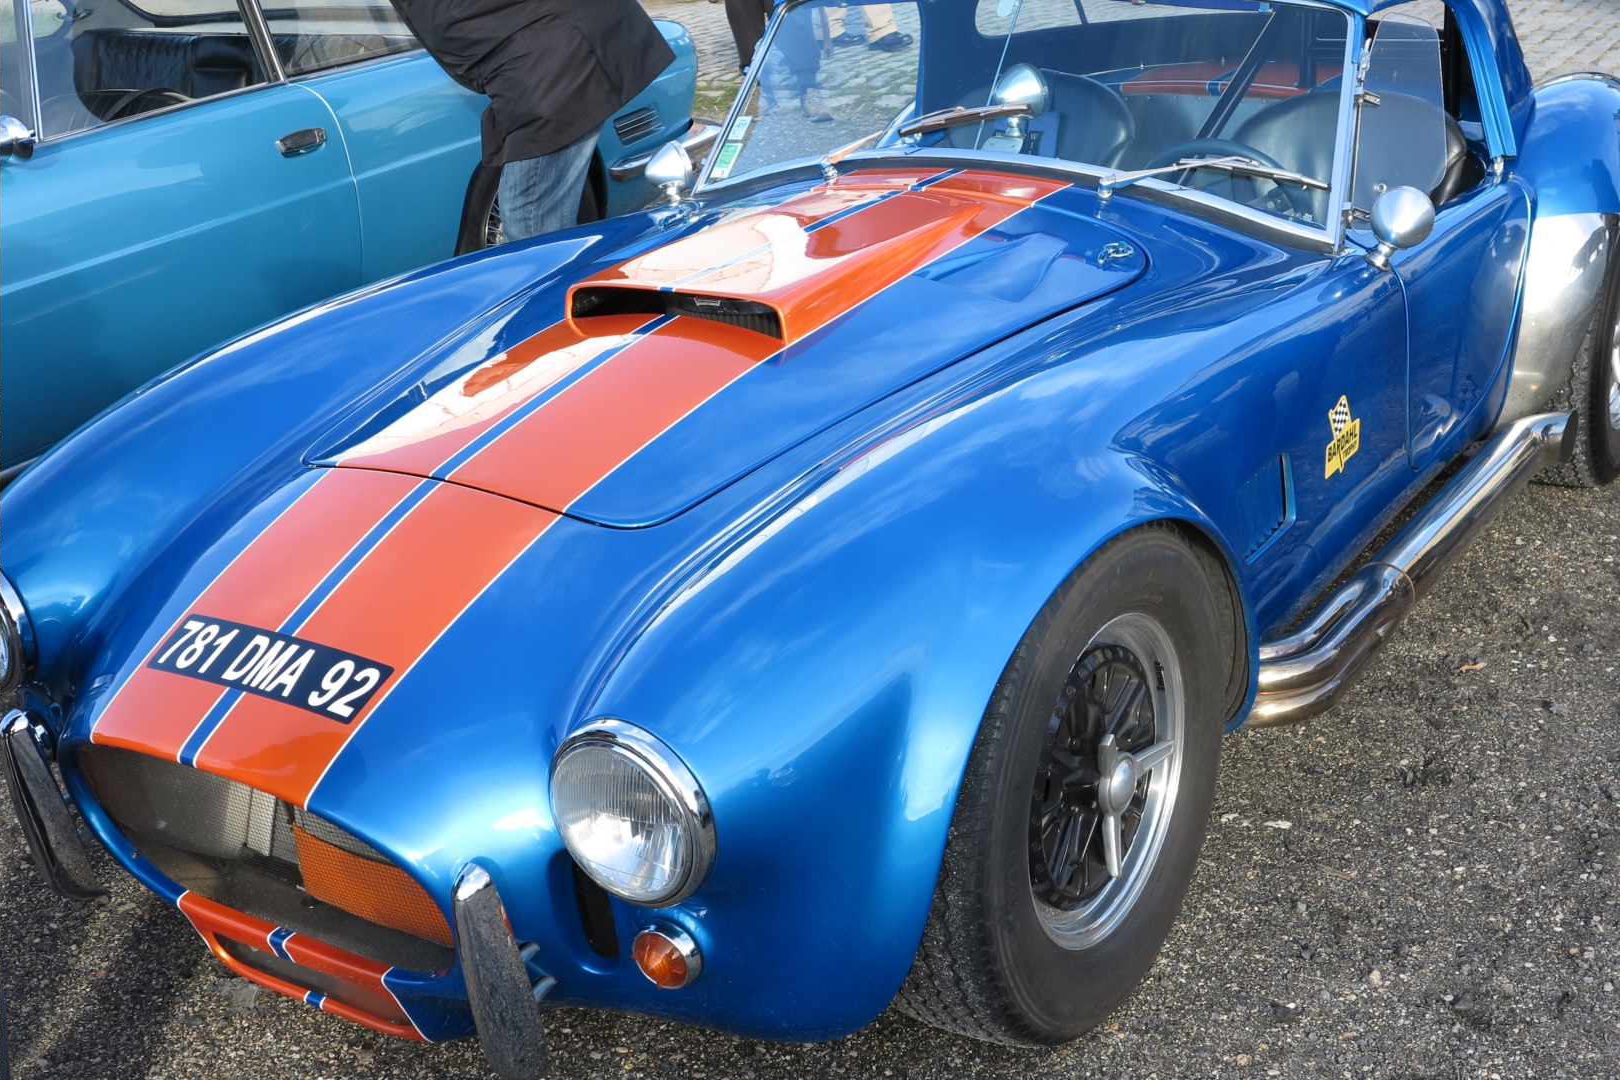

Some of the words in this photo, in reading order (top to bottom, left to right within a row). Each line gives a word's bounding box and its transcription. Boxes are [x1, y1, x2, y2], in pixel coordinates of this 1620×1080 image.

[1328, 423, 1357, 463] BARDAHL
[157, 620, 240, 674] 781
[221, 634, 316, 698] DMA
[307, 659, 381, 718] 92
[1025, 705, 1045, 760] RADIAL
